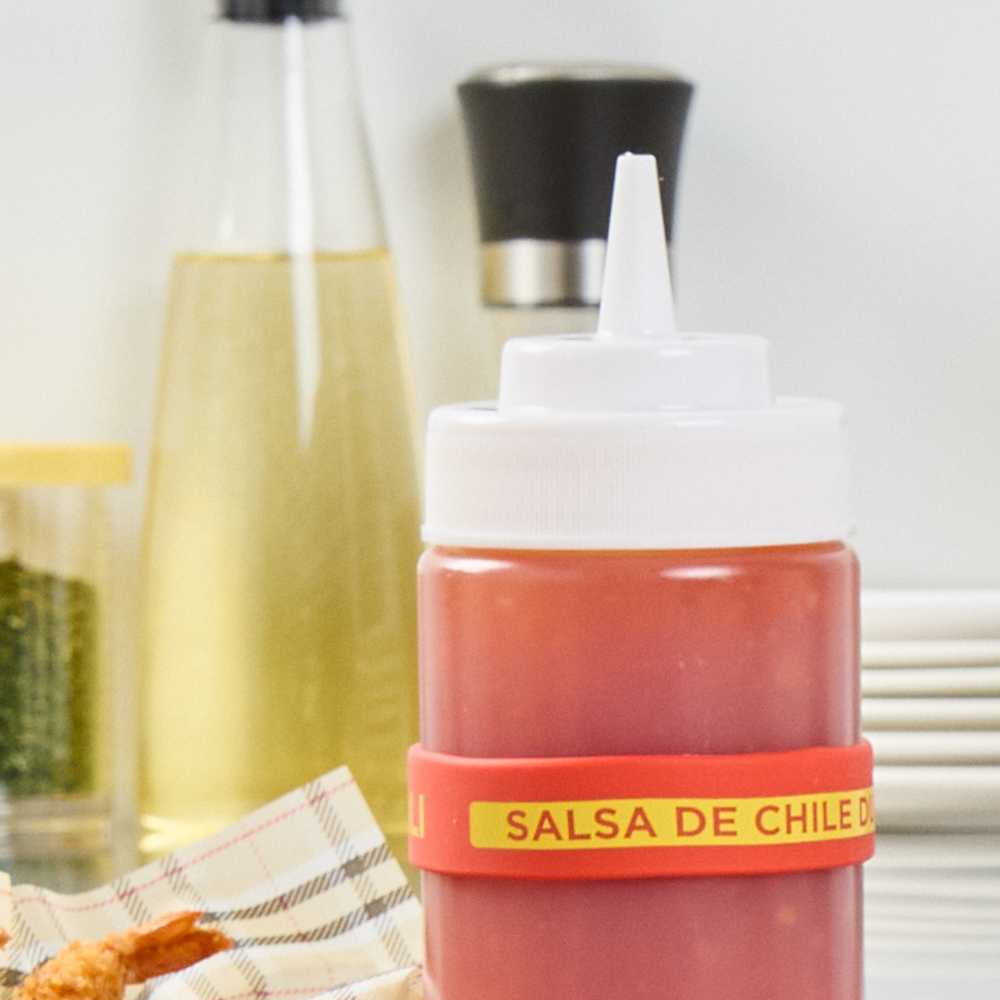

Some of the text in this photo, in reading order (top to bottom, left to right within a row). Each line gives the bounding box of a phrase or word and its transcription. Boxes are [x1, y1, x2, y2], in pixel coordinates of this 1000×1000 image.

[505, 807, 657, 841] SALSA
[675, 806, 738, 838] DE
[754, 798, 852, 835] CHILE
